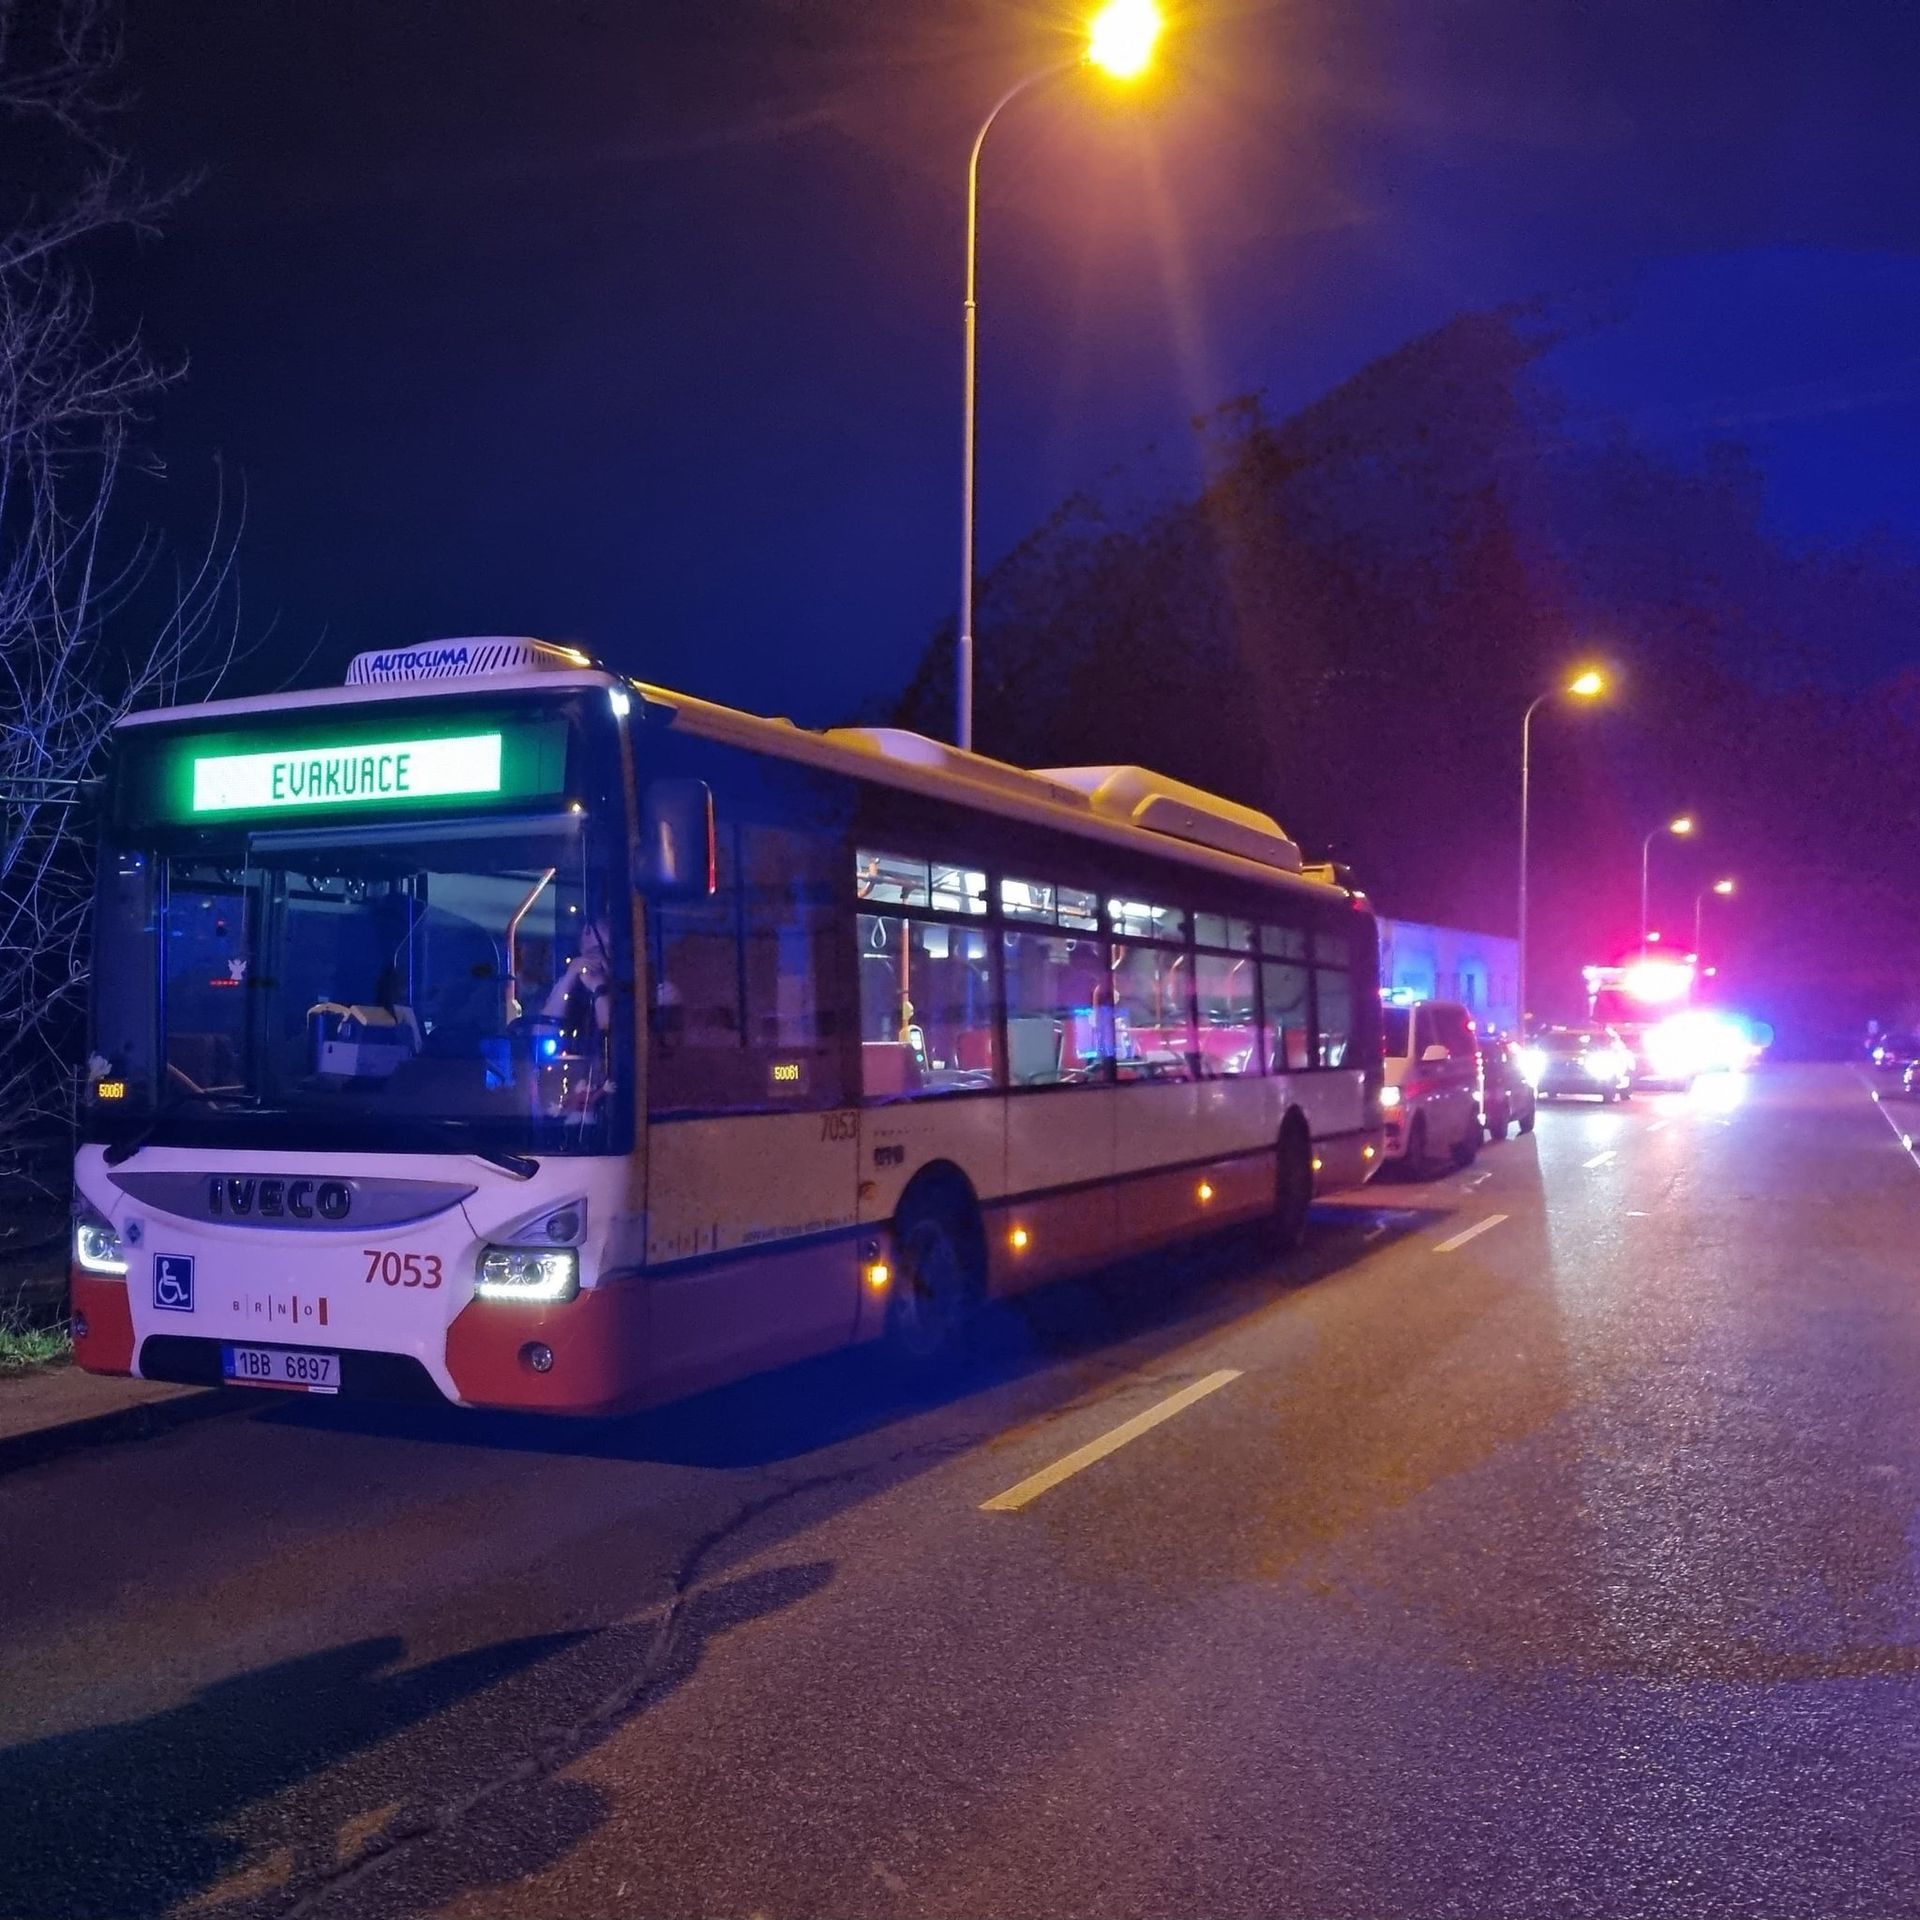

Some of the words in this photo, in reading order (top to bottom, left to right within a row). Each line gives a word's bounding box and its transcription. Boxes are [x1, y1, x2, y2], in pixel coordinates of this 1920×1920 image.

[371, 647, 469, 672] AUTOCLIMA
[273, 753, 411, 799] EVAKUACE
[774, 1065, 799, 1080] 50061
[99, 1083, 123, 1098] 50061
[209, 1177, 350, 1220] IVECO
[363, 1250, 442, 1289] 7053
[239, 1352, 271, 1376] 1BB
[285, 1356, 330, 1380] 6897
